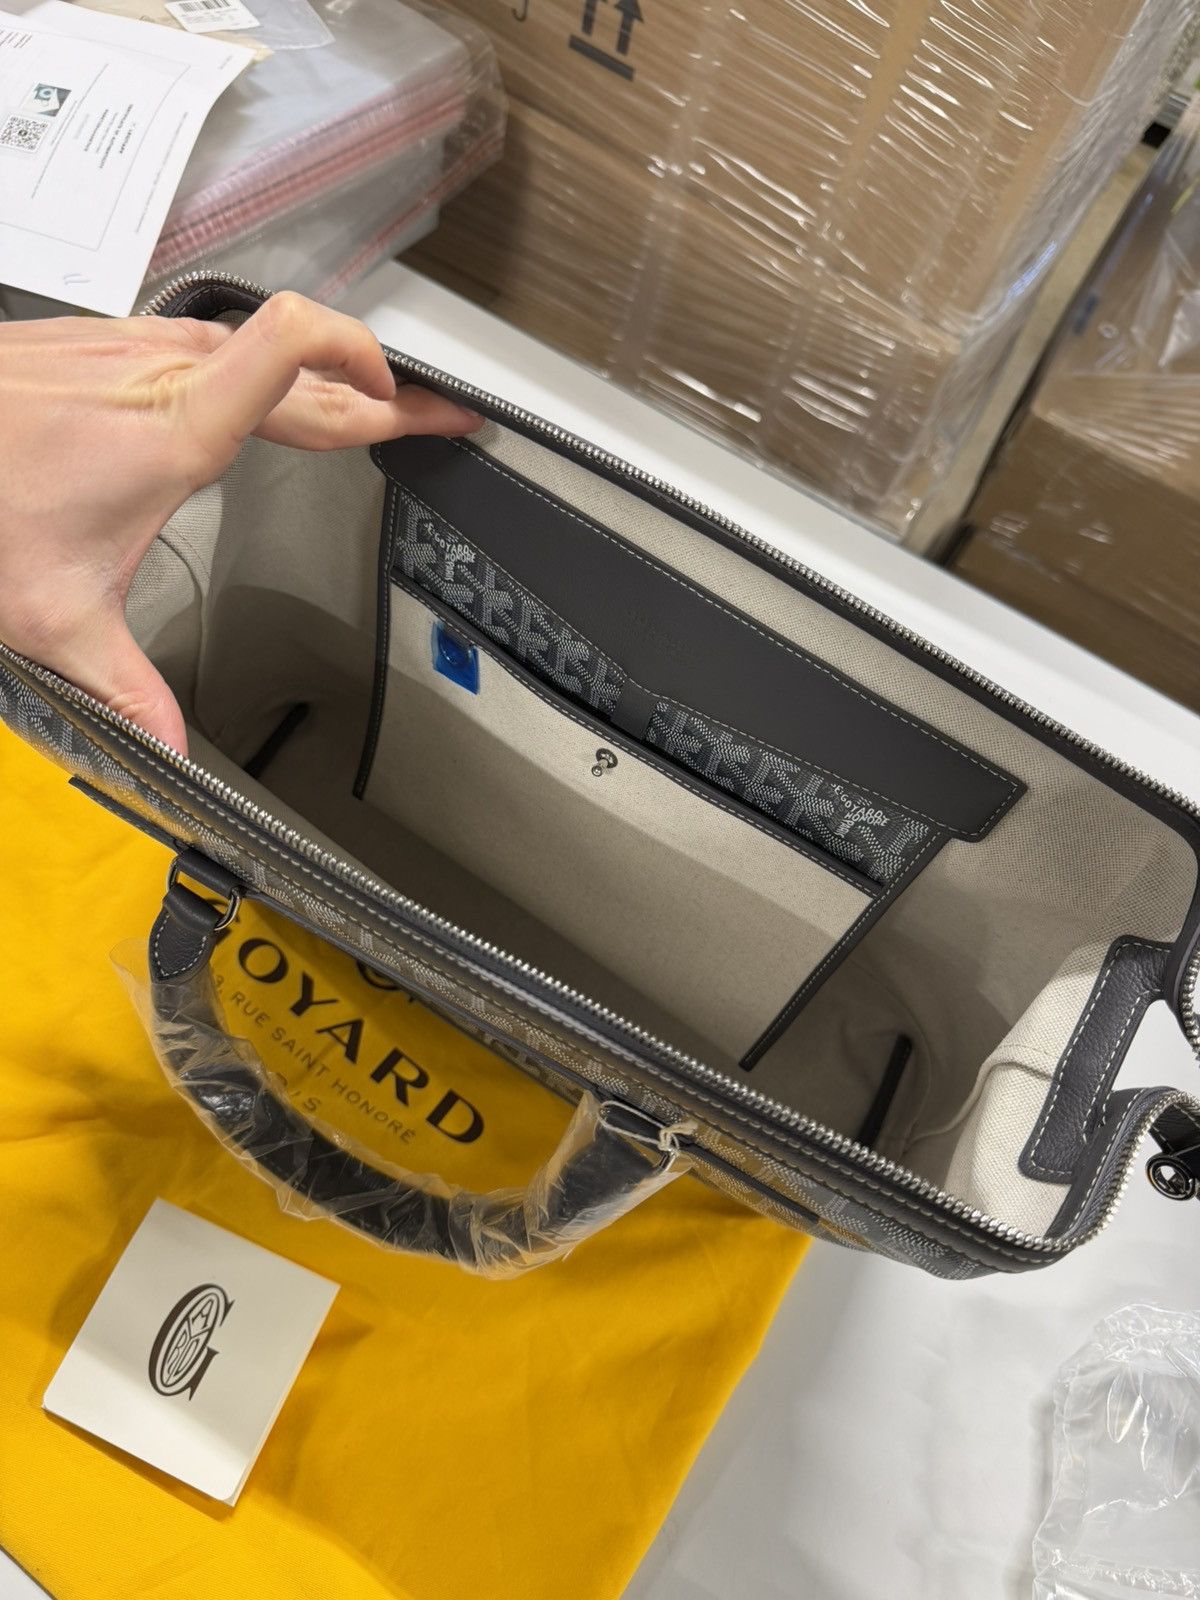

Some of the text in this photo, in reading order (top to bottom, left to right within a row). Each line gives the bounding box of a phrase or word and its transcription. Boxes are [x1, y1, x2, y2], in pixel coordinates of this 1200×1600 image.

[207, 897, 485, 1144] OYARD
[231, 992, 266, 1028] RUE
[271, 1026, 330, 1078] SAINT
[332, 1079, 417, 1145] HONORÉ
